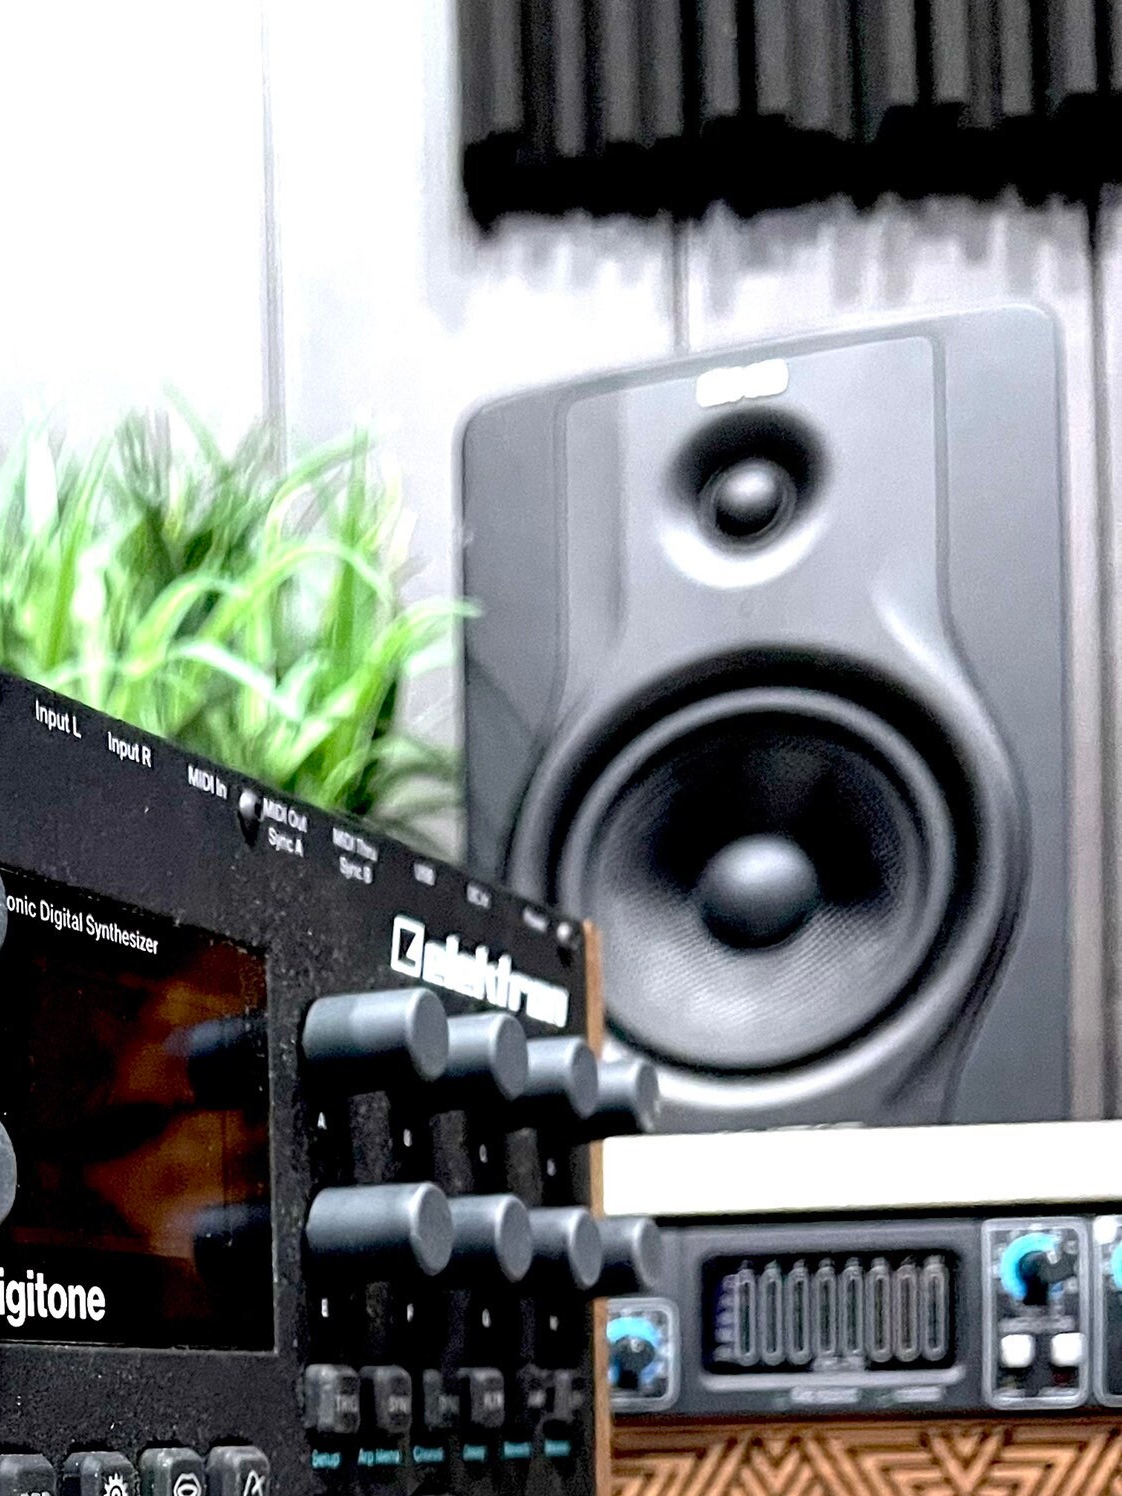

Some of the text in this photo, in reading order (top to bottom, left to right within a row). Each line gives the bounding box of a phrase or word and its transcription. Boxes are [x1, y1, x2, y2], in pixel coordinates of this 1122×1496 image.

[35, 700, 82, 739] Input L
[107, 731, 152, 768] Input R
[188, 764, 228, 800] MIDI In
[40, 899, 83, 932] Digital
[86, 913, 159, 955] Synthesizer
